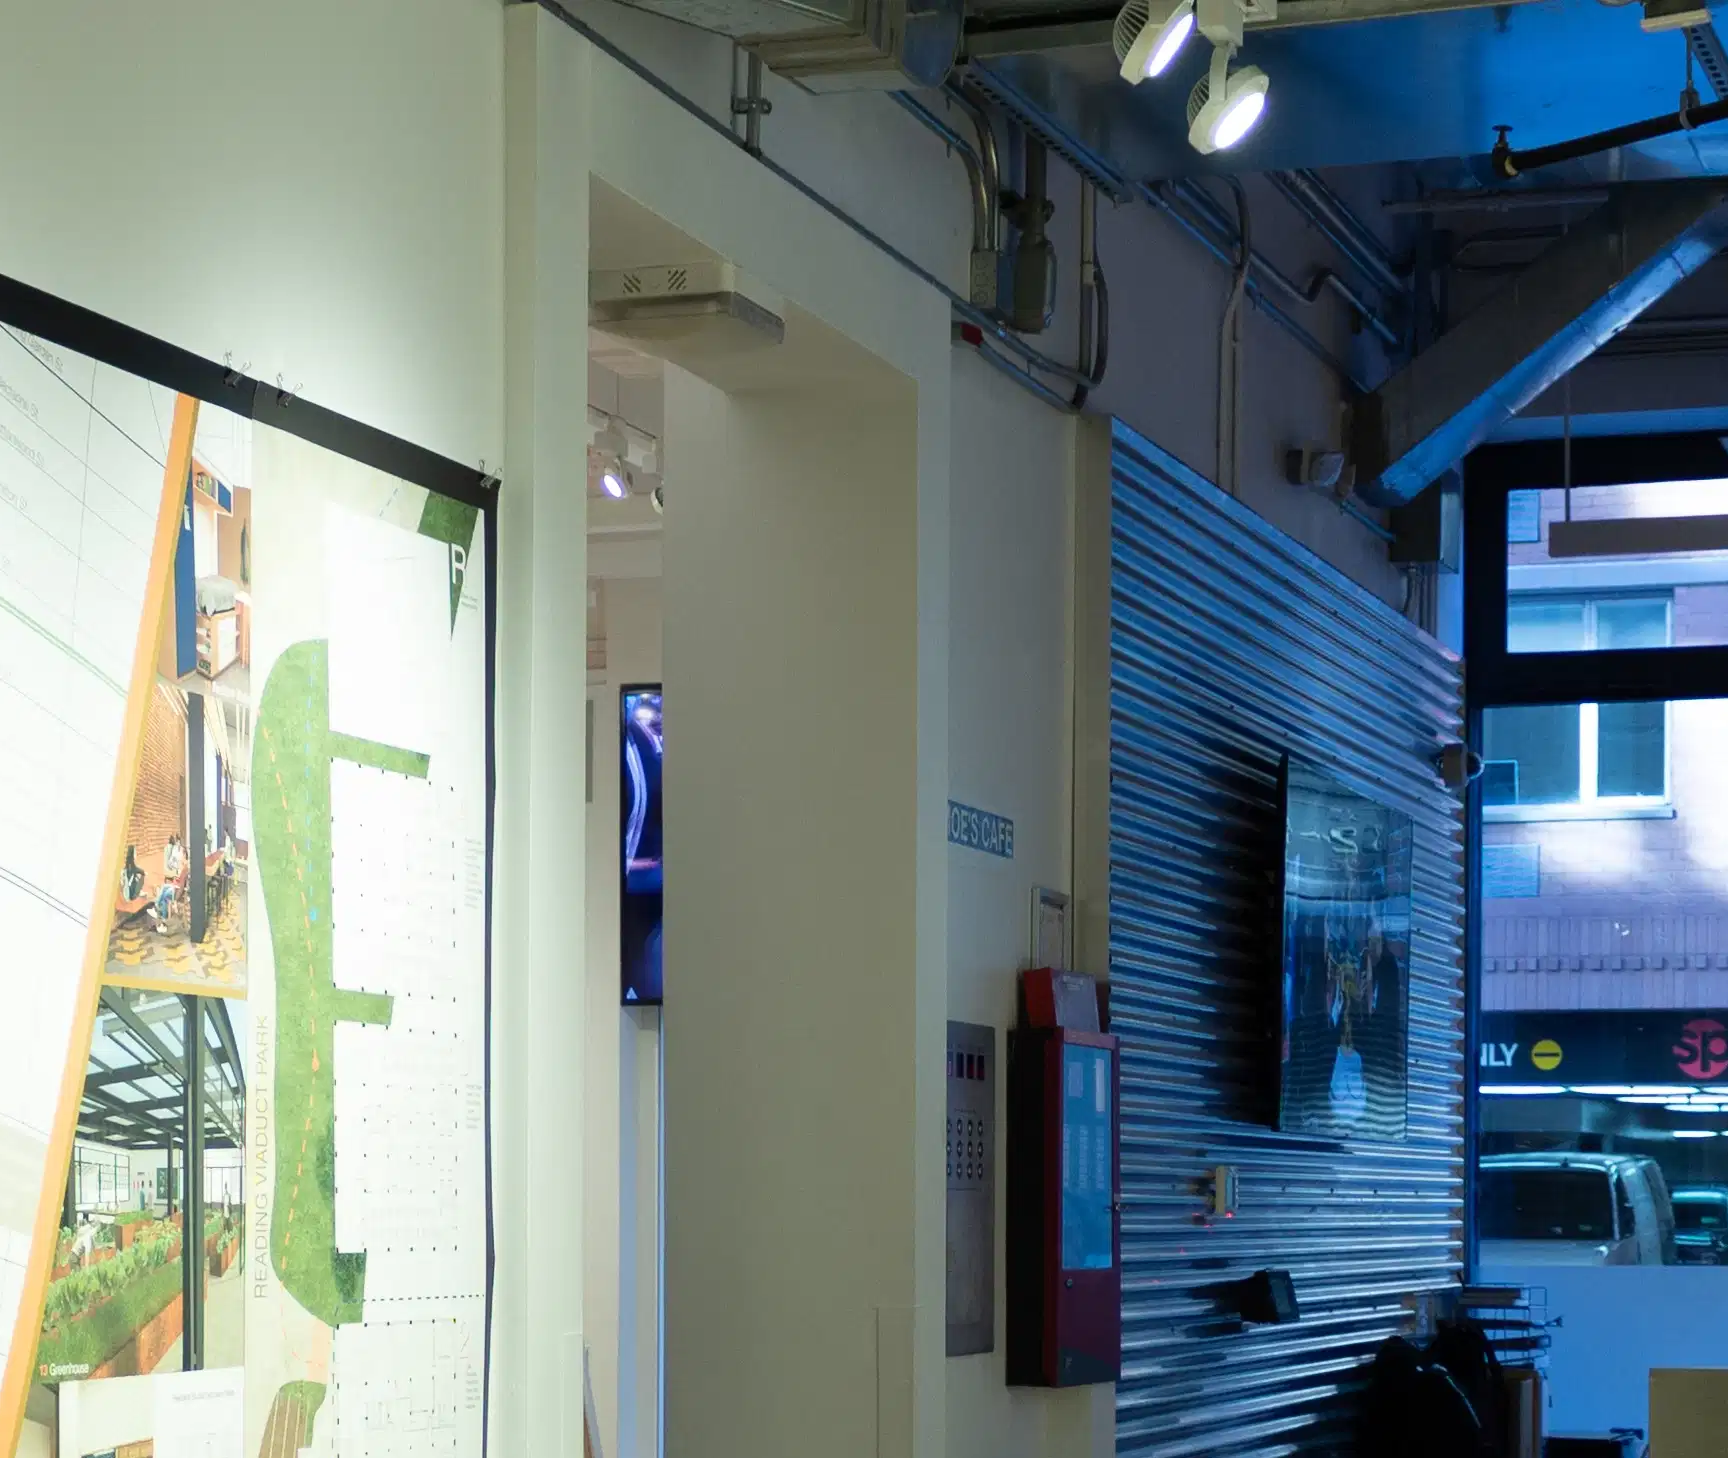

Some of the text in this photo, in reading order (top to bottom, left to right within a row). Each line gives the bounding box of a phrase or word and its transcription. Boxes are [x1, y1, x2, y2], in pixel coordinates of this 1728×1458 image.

[948, 806, 1013, 857] OE'S CAFE
[254, 1015, 269, 1299] READING VIADUCT PARK
[49, 1361, 90, 1377] Greenhouse
